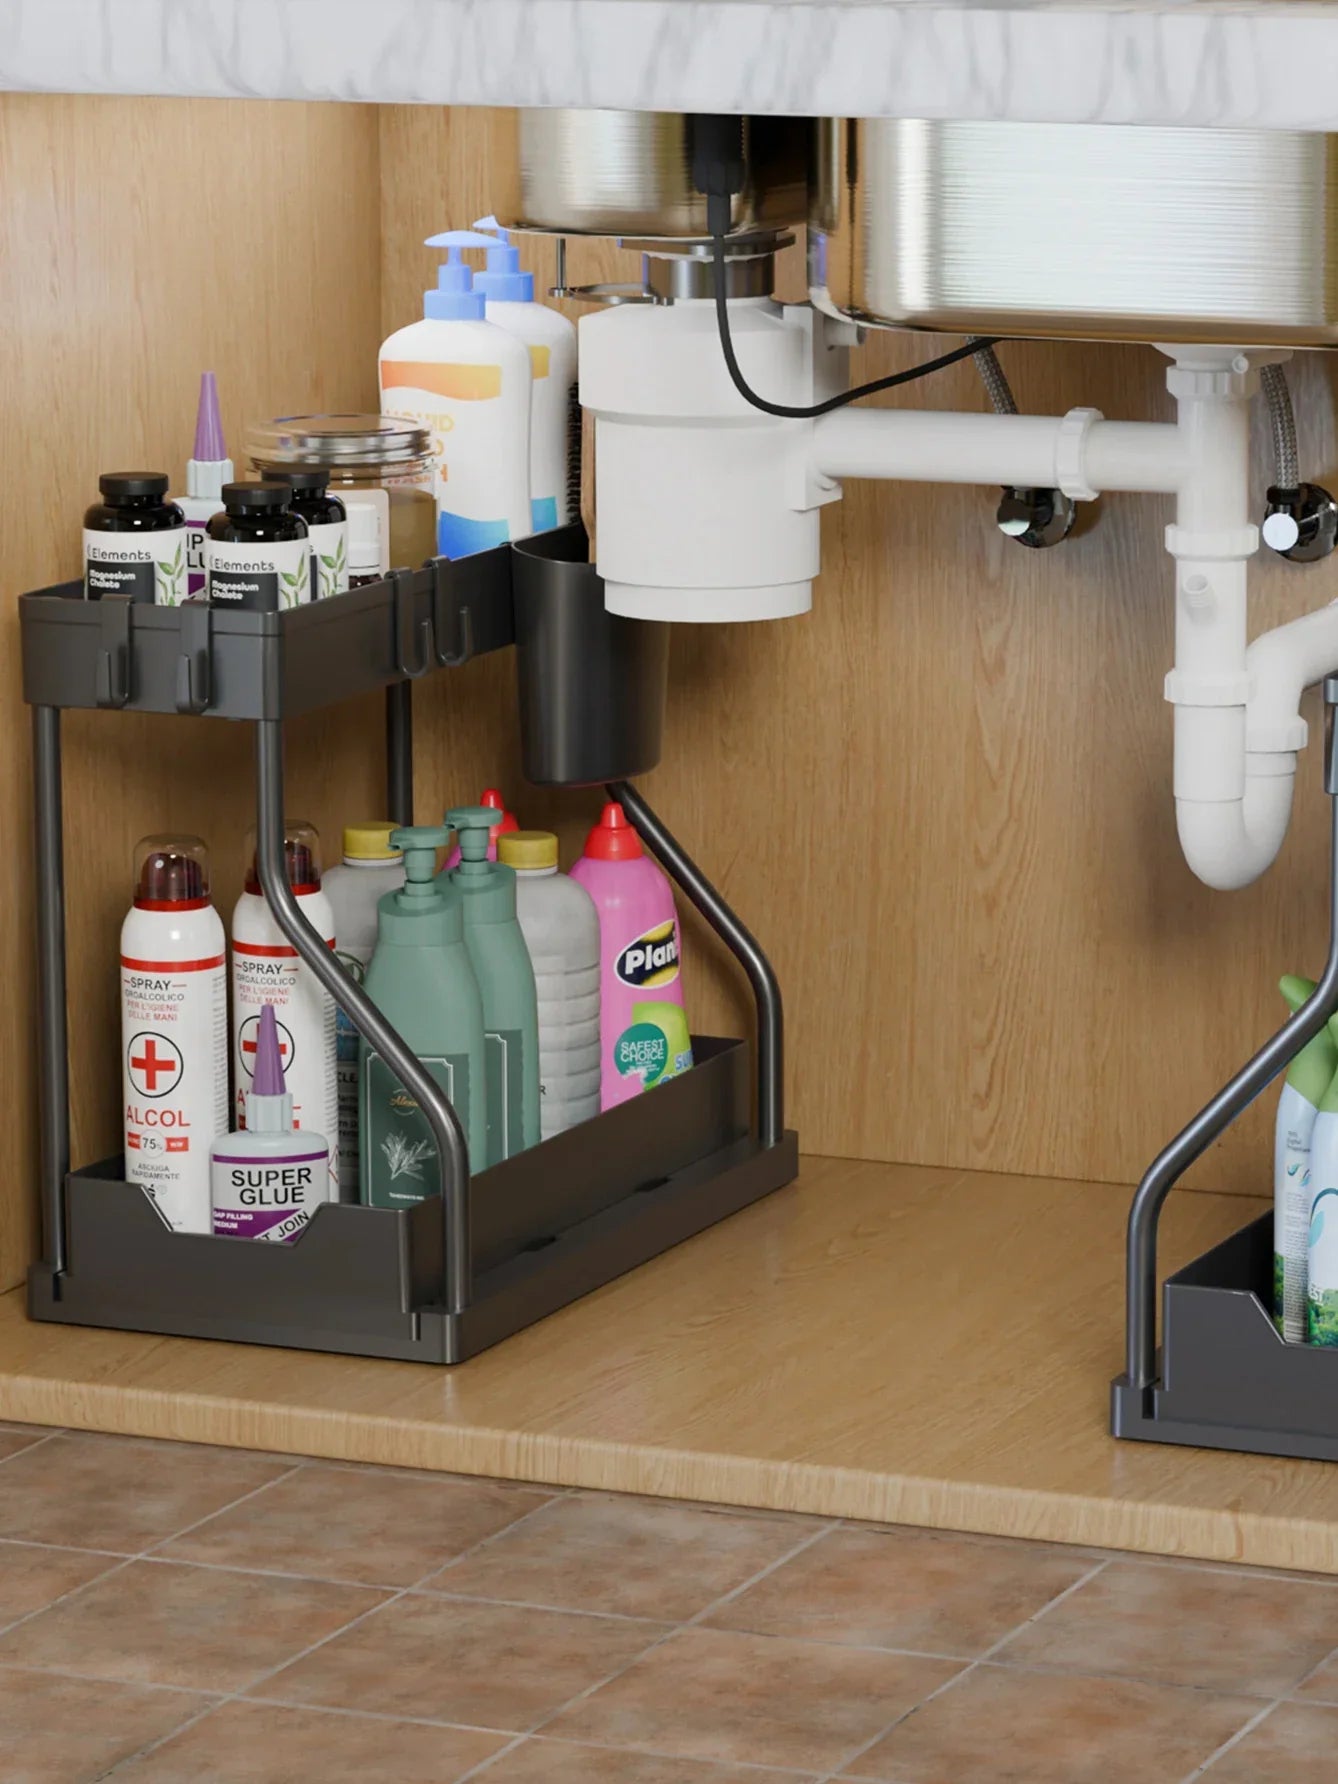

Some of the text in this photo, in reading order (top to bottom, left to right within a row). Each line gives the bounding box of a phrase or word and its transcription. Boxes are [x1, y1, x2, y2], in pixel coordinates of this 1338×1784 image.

[240, 961, 283, 975] SPRAY
[130, 976, 171, 991] SPRAY
[621, 1039, 664, 1051] SAFEST
[620, 1049, 664, 1062] CHOICE
[126, 1104, 191, 1128] ALCOL
[231, 1167, 312, 1187] SUPER
[240, 1186, 304, 1205] GLUE
[278, 1211, 309, 1238] JOIN
